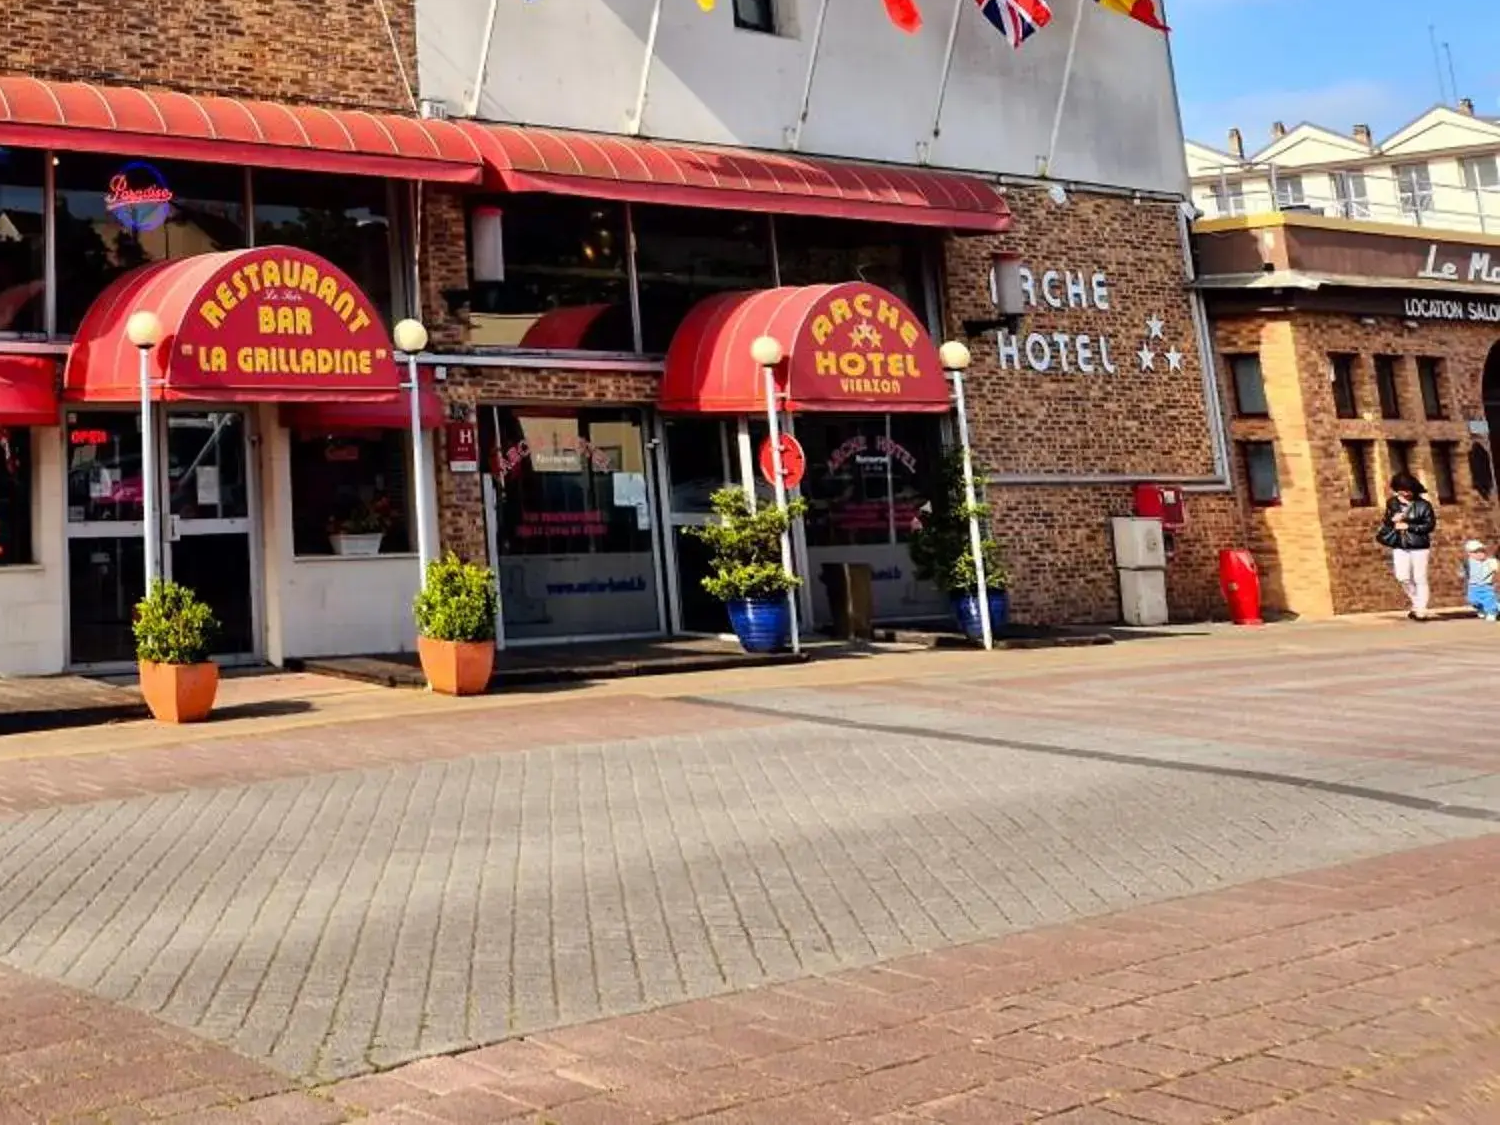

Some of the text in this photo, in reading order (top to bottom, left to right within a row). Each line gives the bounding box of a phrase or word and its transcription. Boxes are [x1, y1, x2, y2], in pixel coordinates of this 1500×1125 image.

[1417, 244, 1458, 280] Le
[200, 258, 371, 333] RESTAURANT
[990, 266, 1109, 310] RCHE
[258, 306, 313, 335] BAR
[812, 293, 919, 348] ARCHE
[1404, 298, 1463, 319] LOCATION
[815, 351, 921, 378] HOTEL
[997, 328, 1117, 373] HOTEL
[840, 379, 901, 394] VIERZON
[459, 430, 473, 445] H
